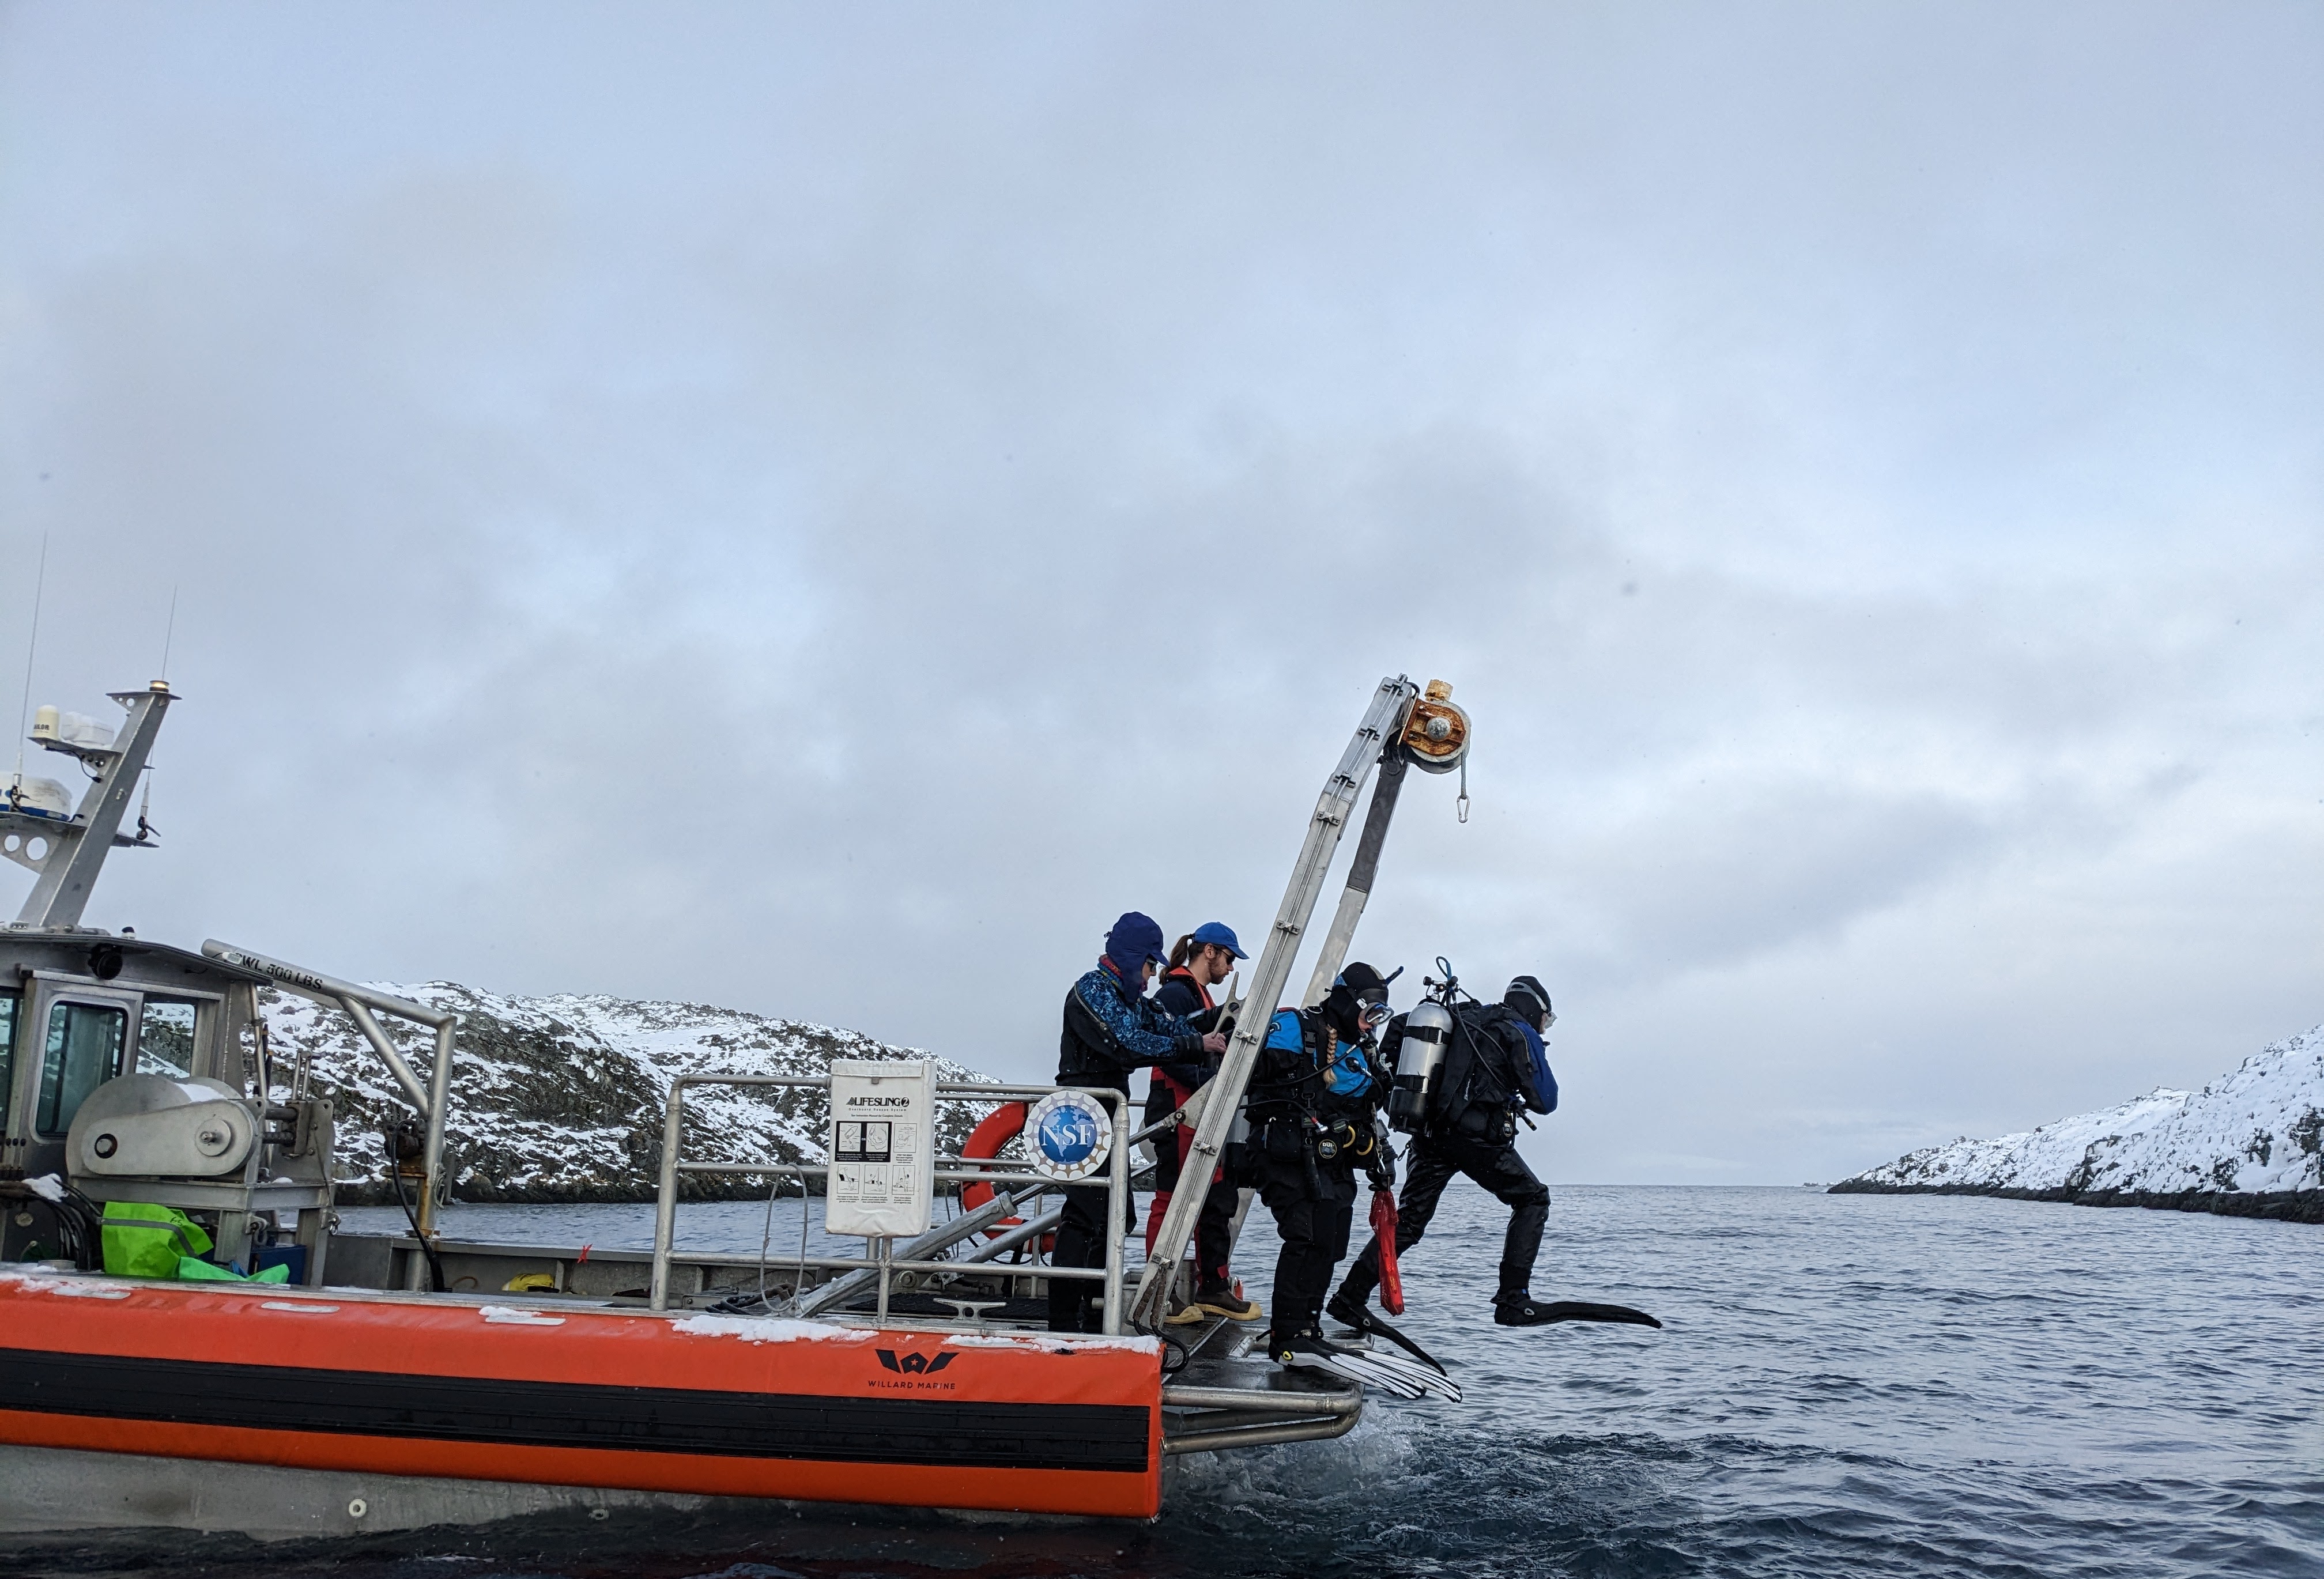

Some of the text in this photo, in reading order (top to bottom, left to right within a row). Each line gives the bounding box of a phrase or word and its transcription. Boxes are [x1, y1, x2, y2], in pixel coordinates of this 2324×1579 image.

[295, 972, 323, 989] LBS
[855, 1097, 900, 1106] LIFESLING
[1041, 1124, 1095, 1146] NSF
[867, 1380, 956, 1390] WILLARD MARINE
